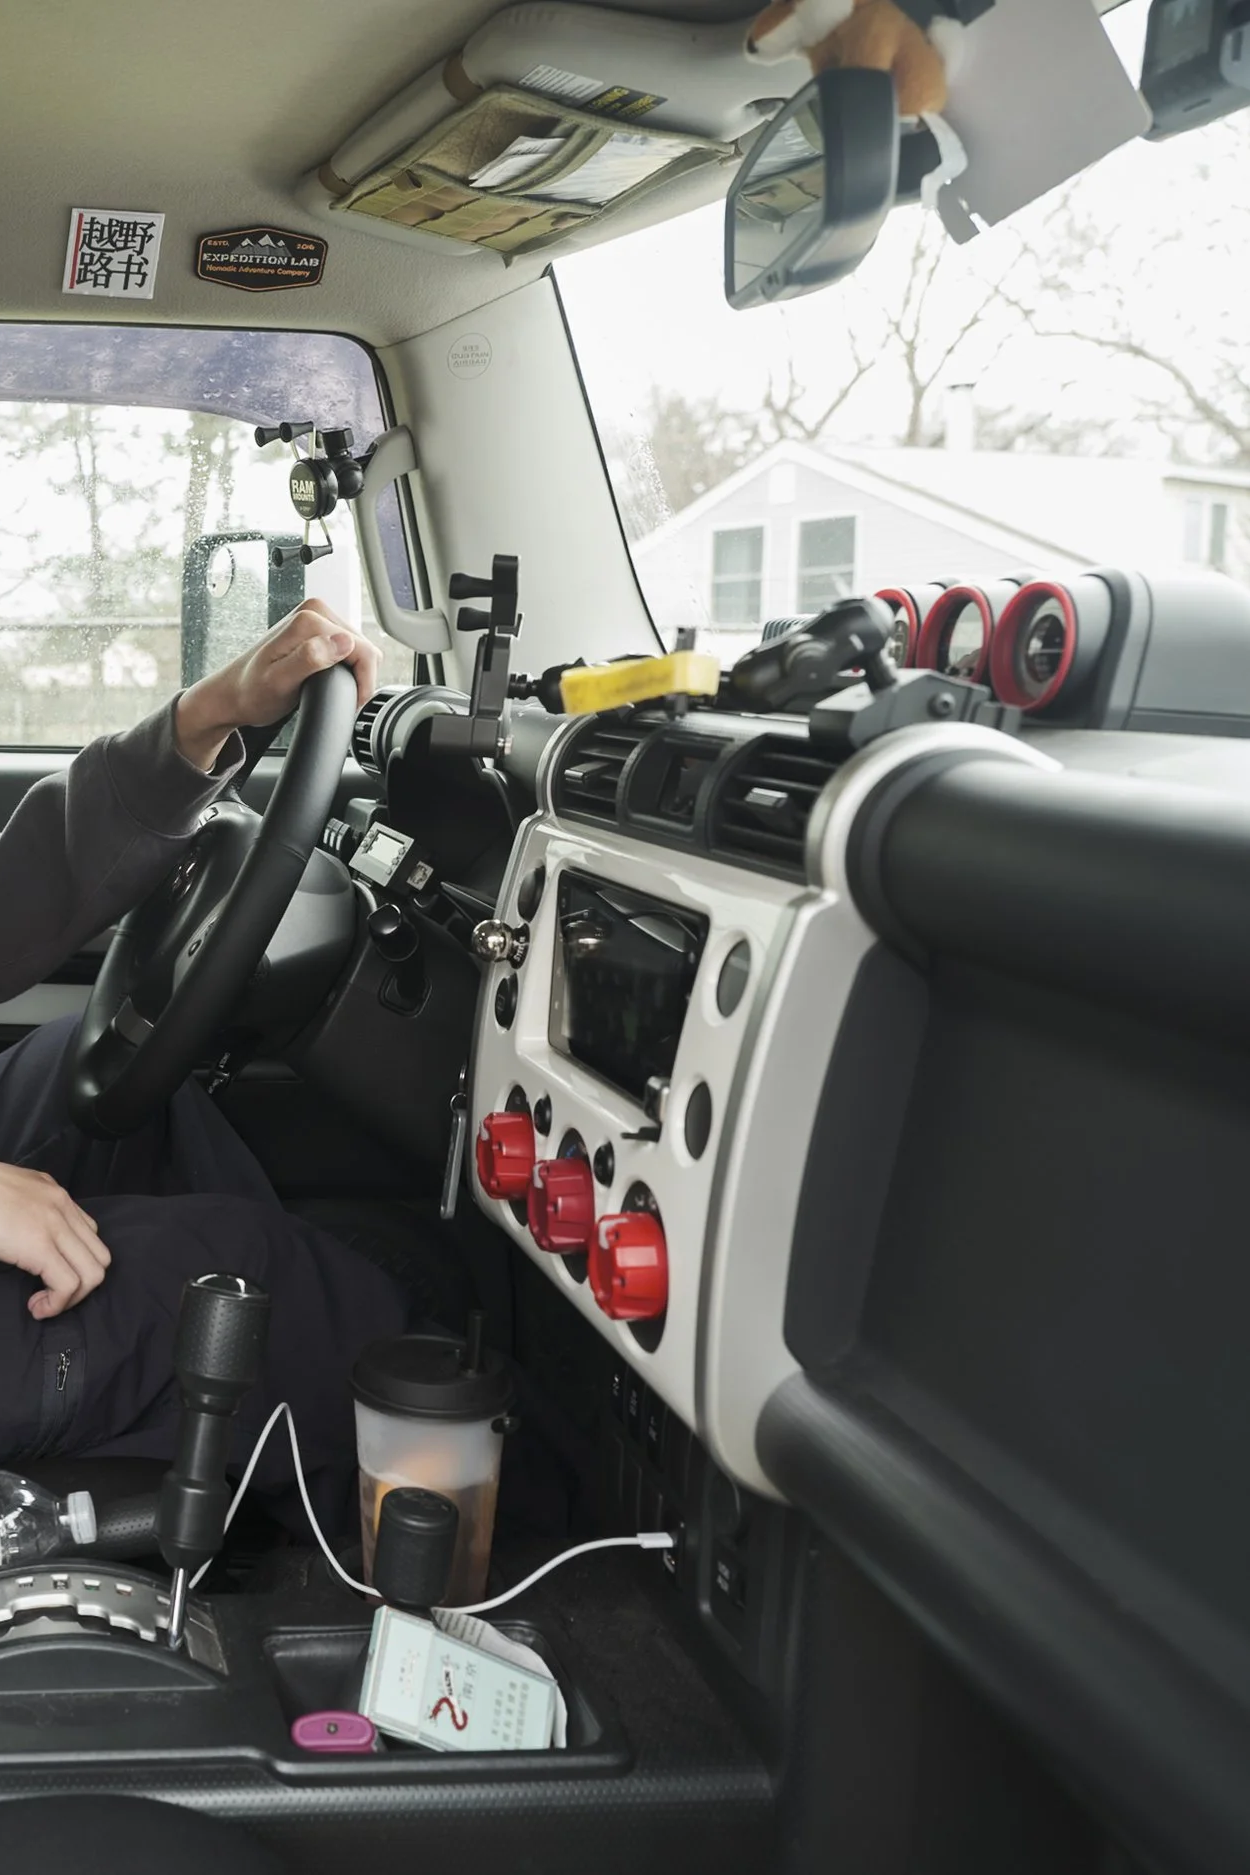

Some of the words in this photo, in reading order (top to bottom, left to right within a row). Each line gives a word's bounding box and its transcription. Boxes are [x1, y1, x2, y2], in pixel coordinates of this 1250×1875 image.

[79, 216, 156, 256] 越野
[76, 252, 148, 291] 路书
[202, 252, 288, 266] EXPEDITION
[290, 257, 320, 267] LAB
[291, 479, 315, 494] RAM
